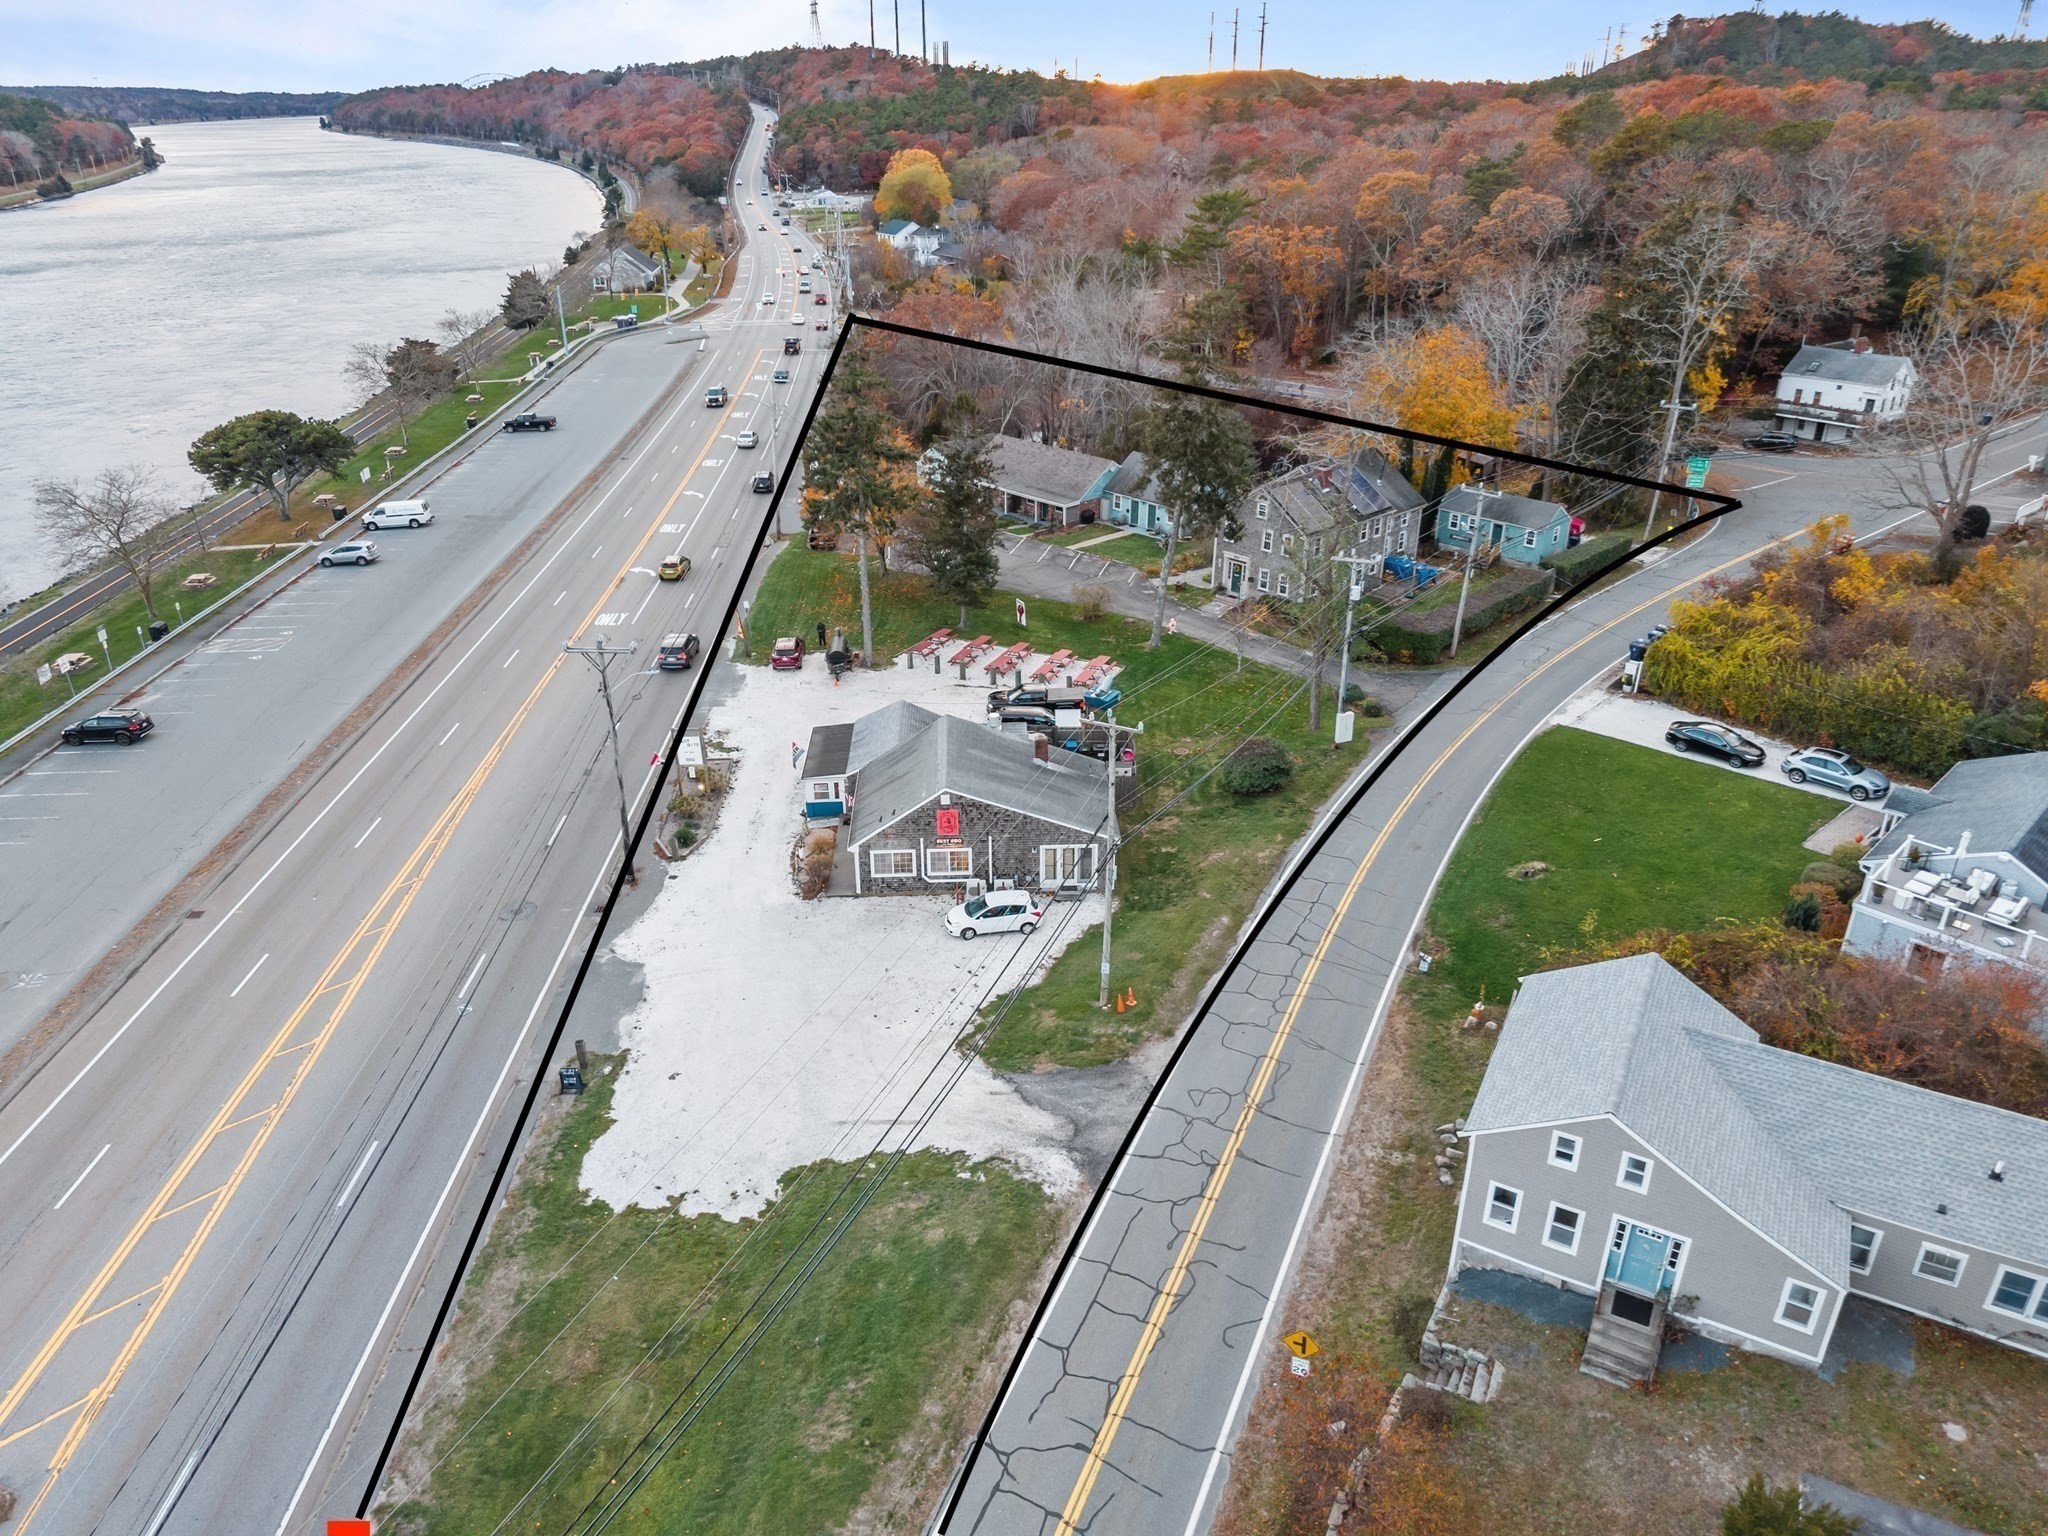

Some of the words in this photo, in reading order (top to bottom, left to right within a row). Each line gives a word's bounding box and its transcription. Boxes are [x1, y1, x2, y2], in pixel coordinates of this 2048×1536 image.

[702, 459, 725, 467] ONLY
[659, 523, 686, 533] ONLY
[594, 612, 629, 626] ONLY
[1293, 1366, 1307, 1375] 20
